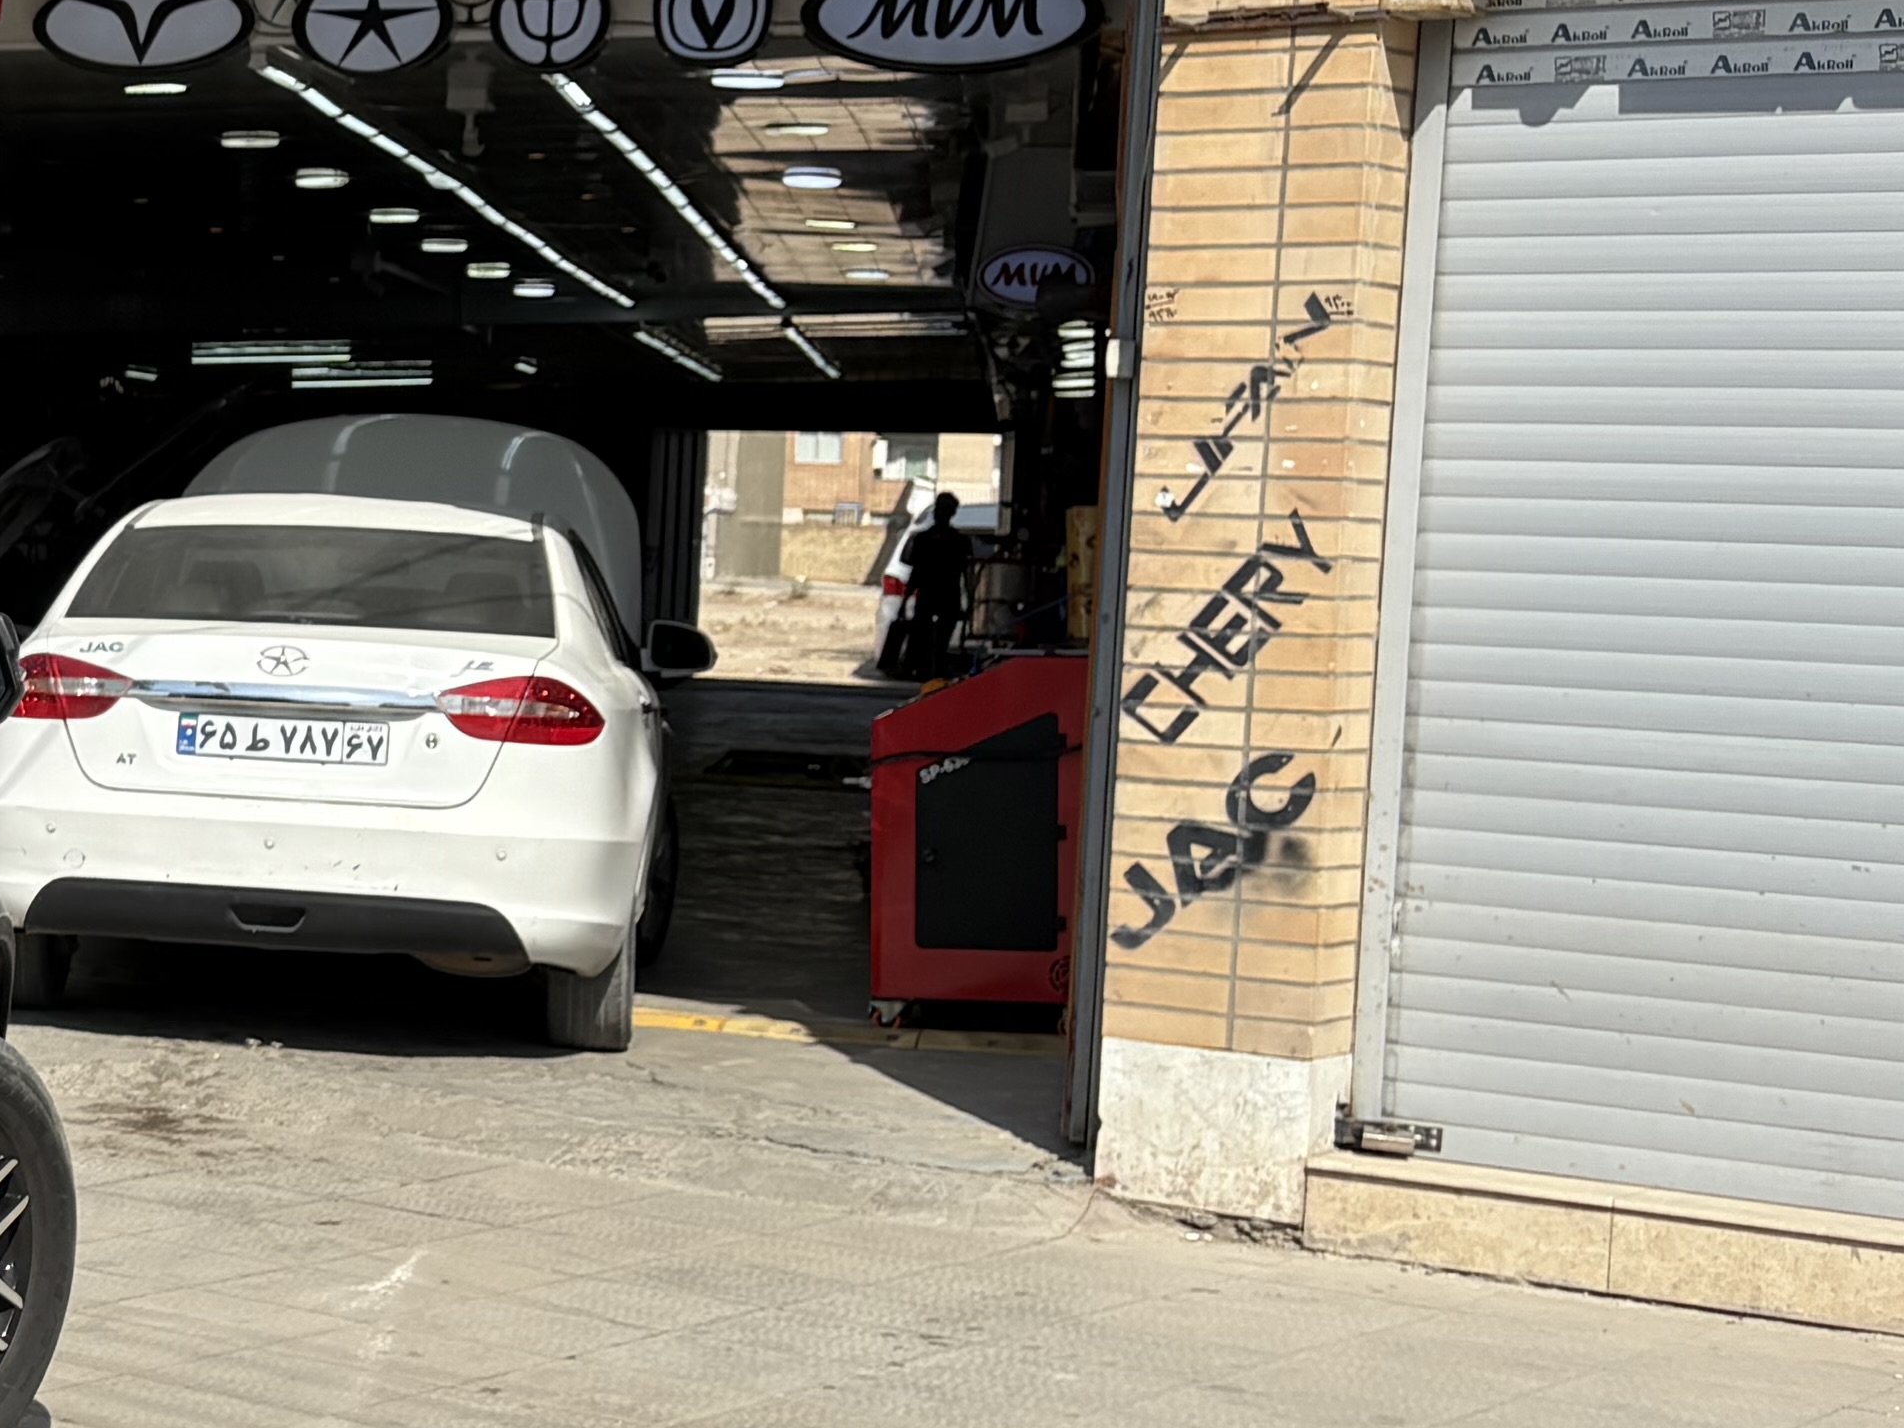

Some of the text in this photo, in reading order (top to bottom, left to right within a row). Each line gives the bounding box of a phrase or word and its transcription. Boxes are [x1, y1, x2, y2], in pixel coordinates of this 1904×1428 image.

[80, 641, 124, 654] JAC
[1121, 508, 1333, 744] CHERY
[1111, 753, 1316, 950] JAC
